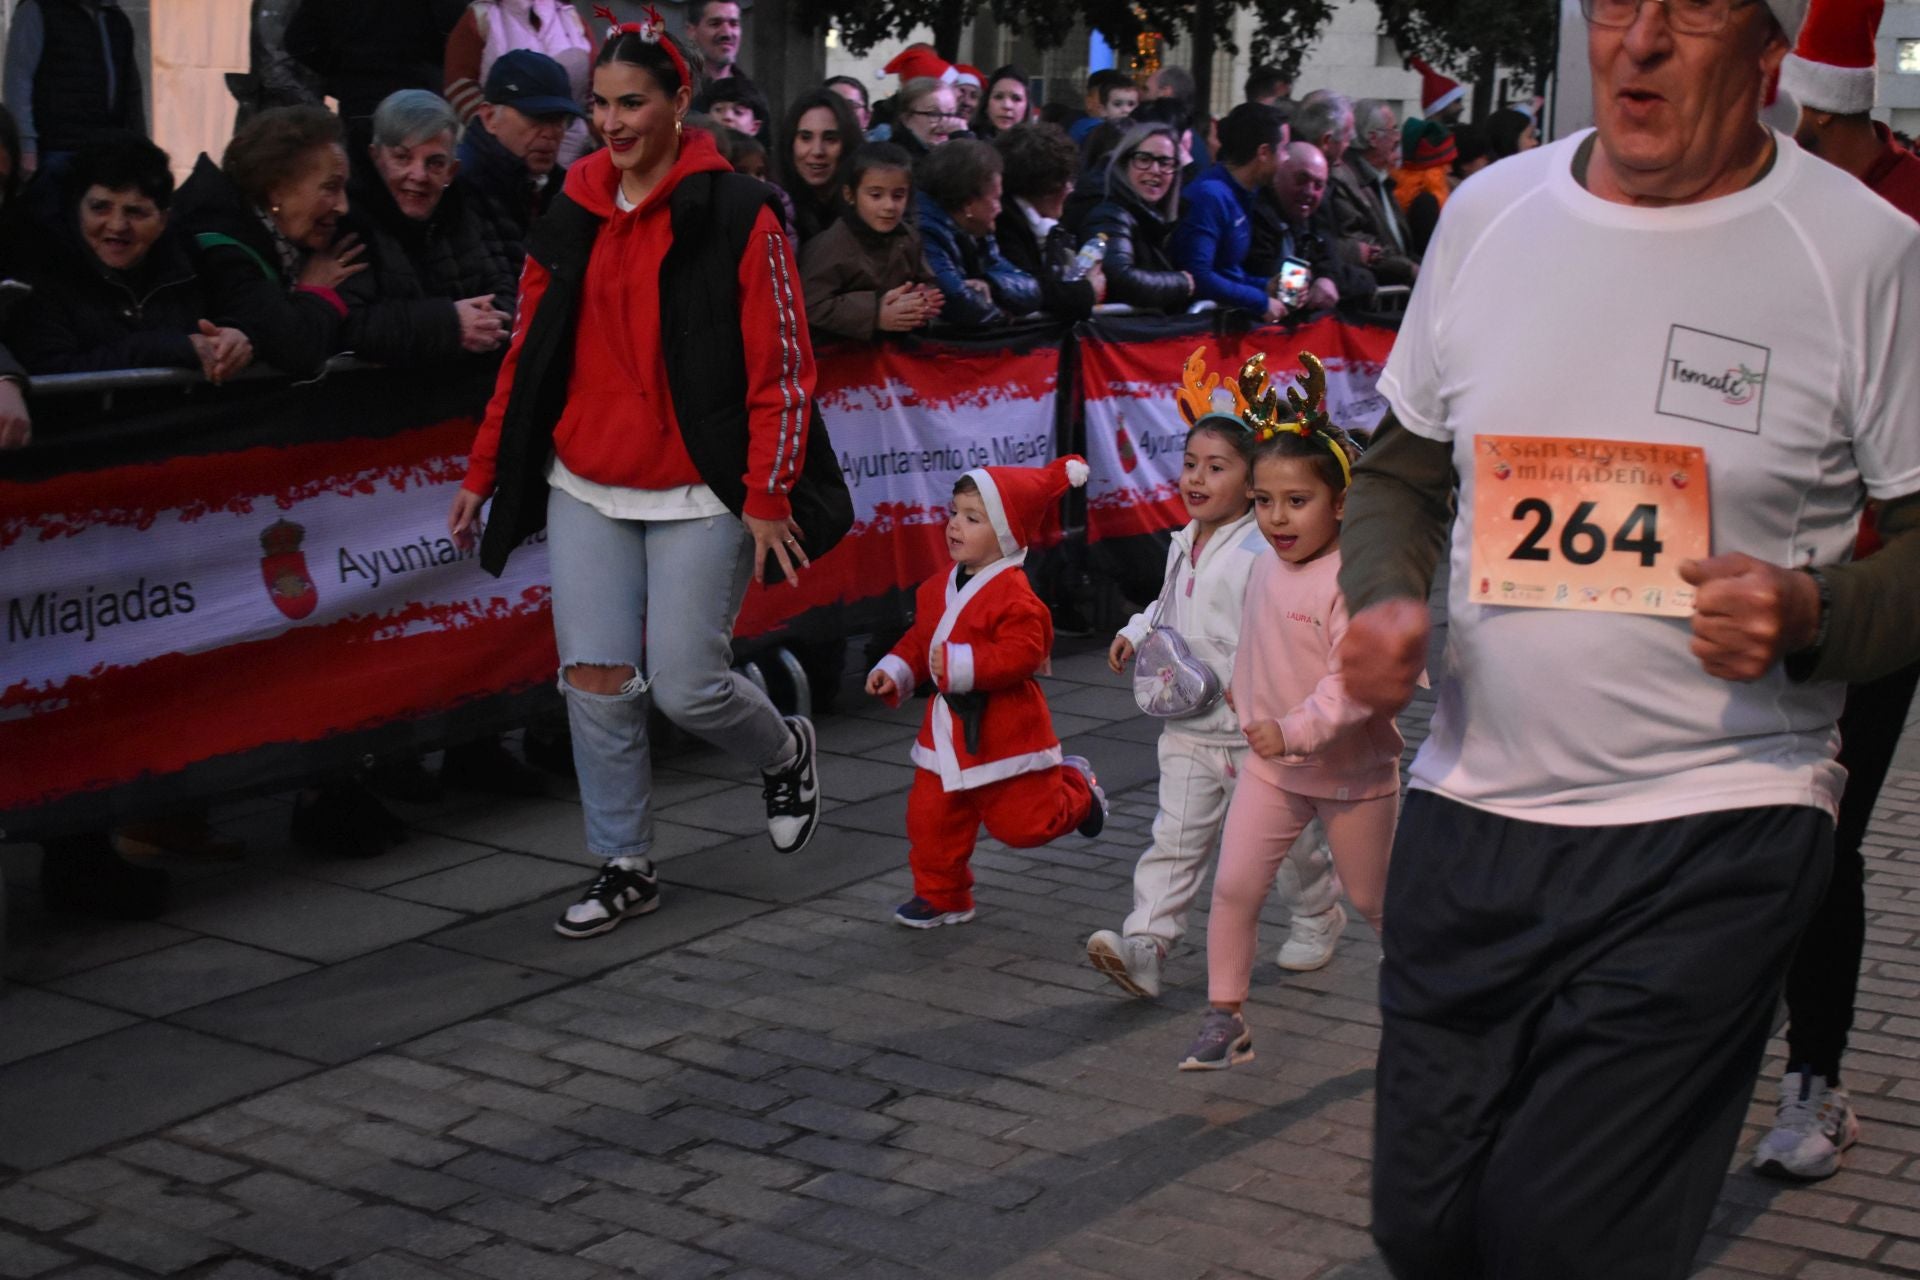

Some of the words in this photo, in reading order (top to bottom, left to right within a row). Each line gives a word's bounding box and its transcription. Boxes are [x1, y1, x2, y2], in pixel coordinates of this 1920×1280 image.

[1668, 358, 1745, 397] Tomate
[967, 440, 990, 468] de
[1510, 441, 1558, 458] SAN
[1508, 497, 1663, 568] 264
[8, 577, 196, 642] Miajadas
[1286, 611, 1312, 624] LAURA
